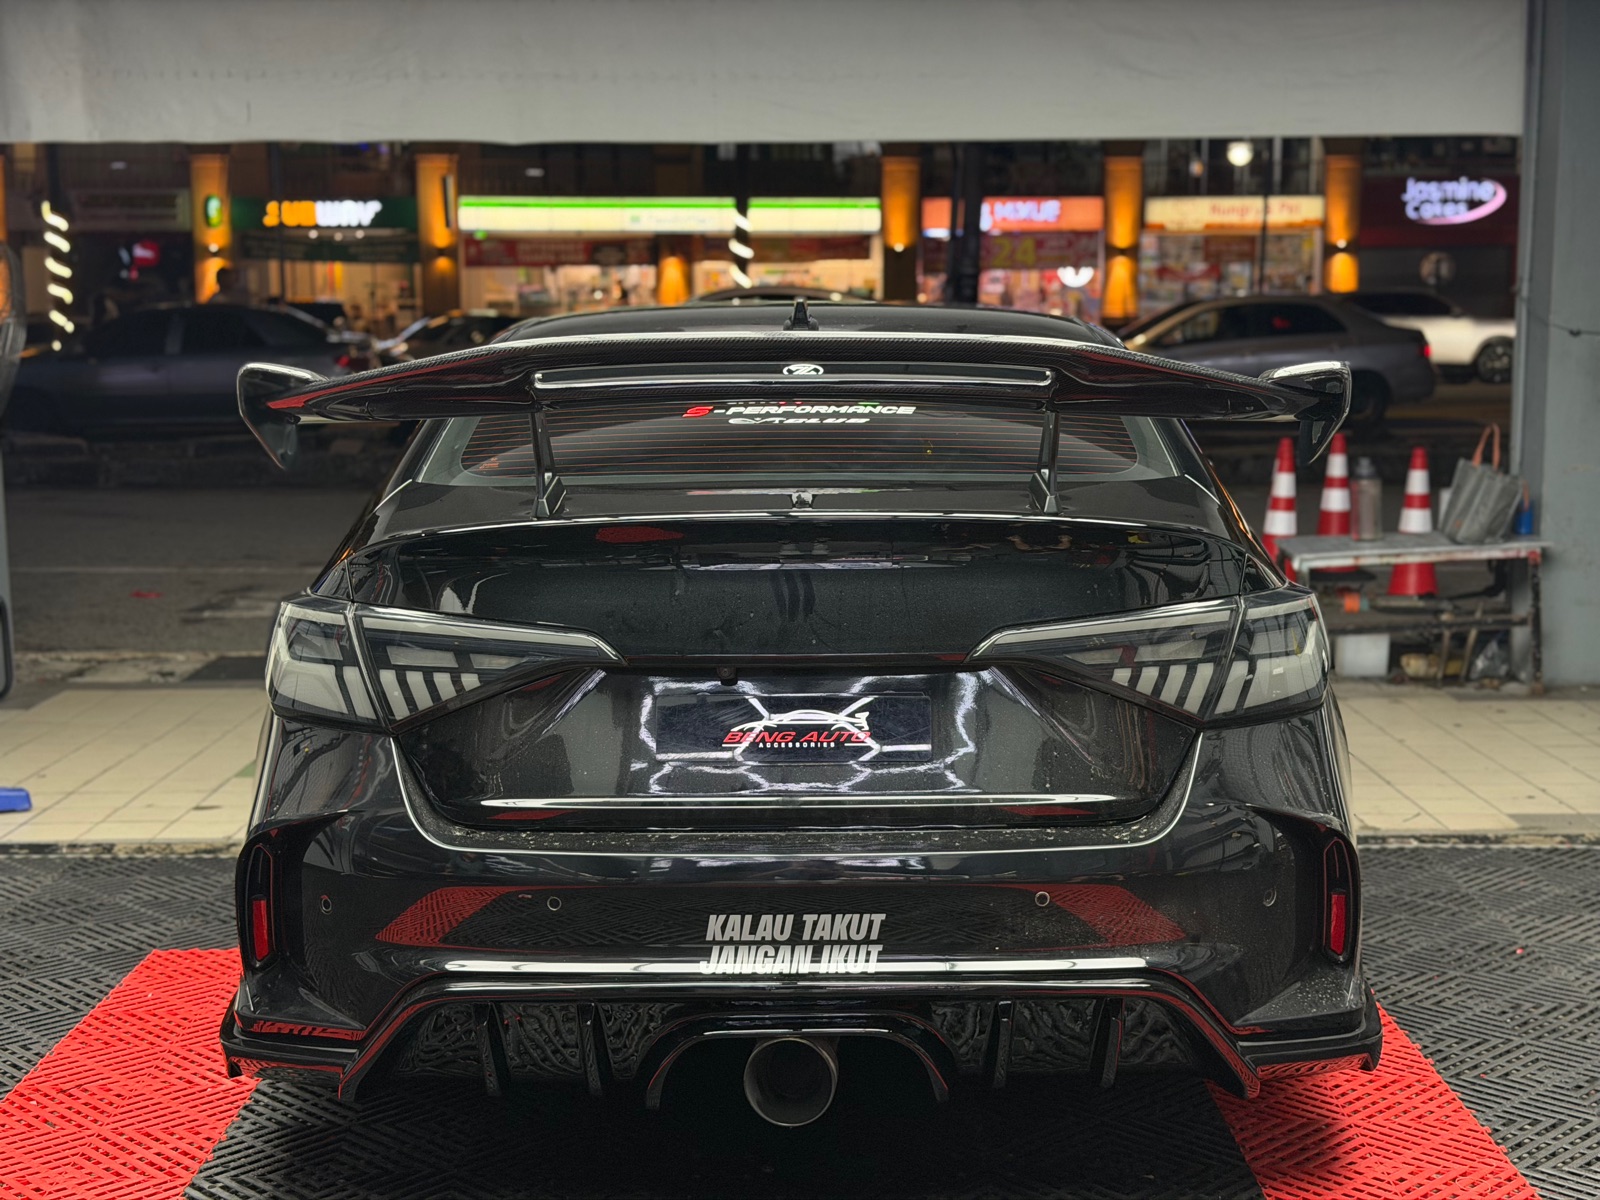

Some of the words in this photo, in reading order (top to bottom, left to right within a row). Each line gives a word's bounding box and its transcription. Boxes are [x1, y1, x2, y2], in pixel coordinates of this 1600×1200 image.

[682, 405, 917, 418] S-PERFORMANCE
[723, 731, 796, 742] BENG
[800, 731, 871, 742] AUTO
[705, 914, 794, 941] KALAU
[802, 913, 886, 941] TAKUT
[700, 944, 813, 974] JANGAN
[818, 944, 883, 974] IKUT
